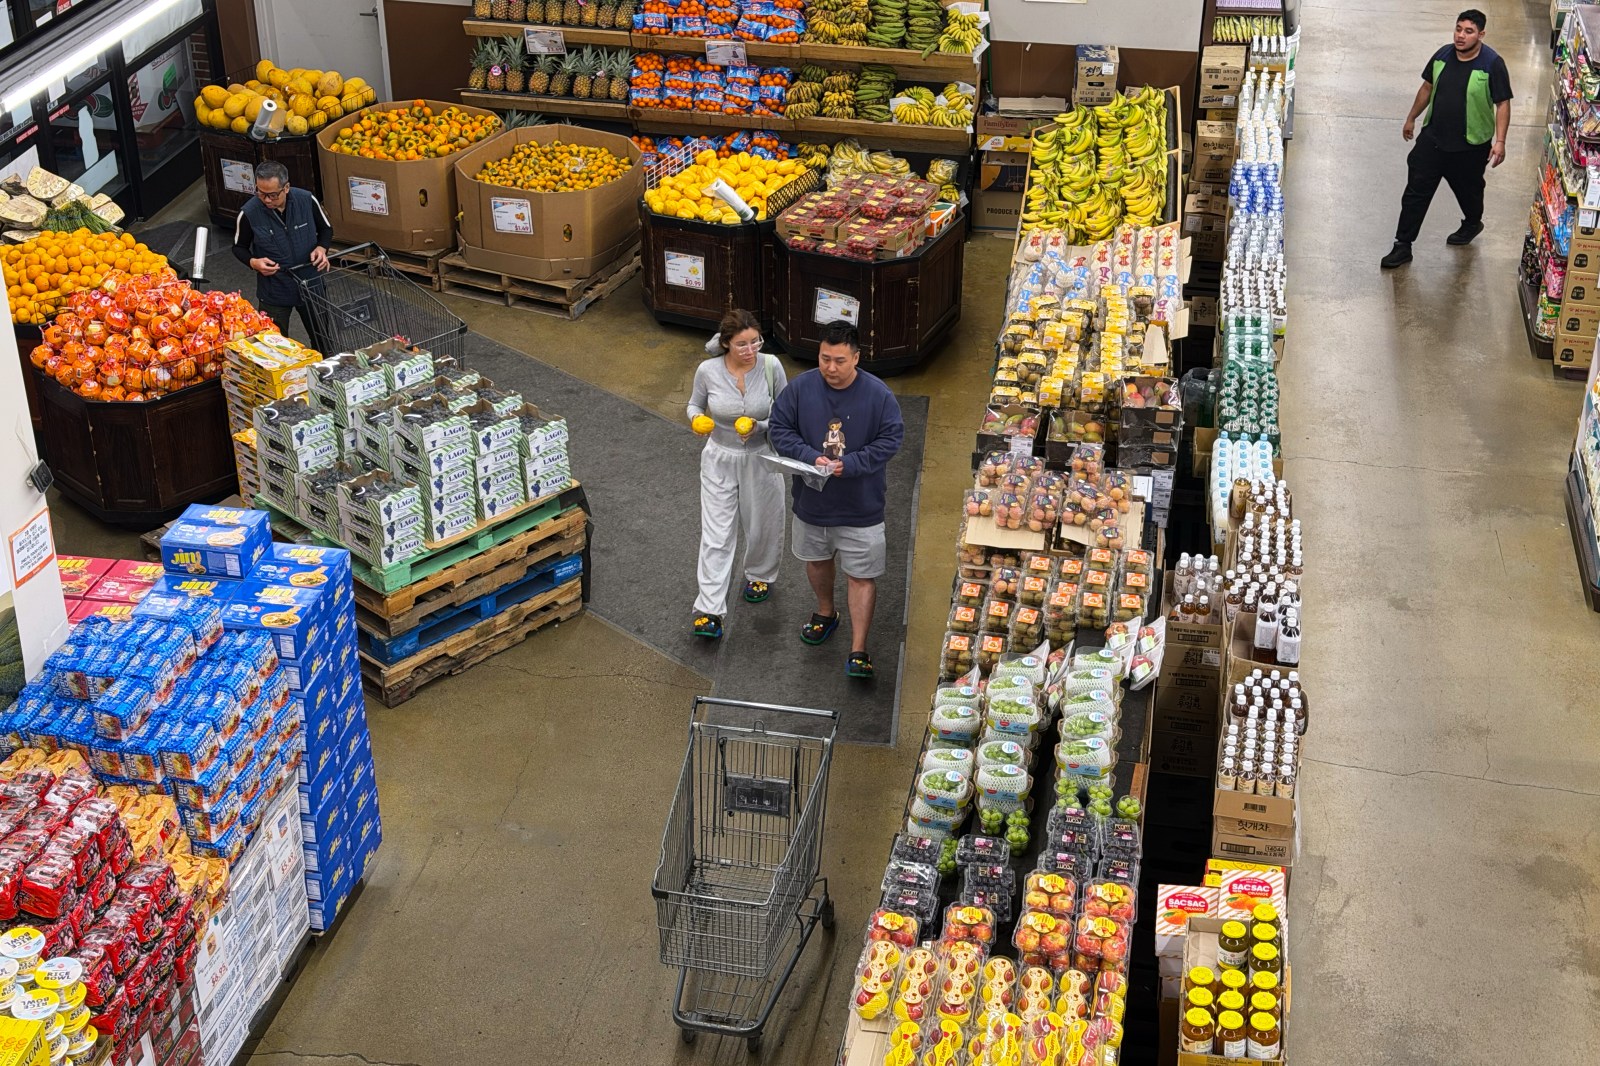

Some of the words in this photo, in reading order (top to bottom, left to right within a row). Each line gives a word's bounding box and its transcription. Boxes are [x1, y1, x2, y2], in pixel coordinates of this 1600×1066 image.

[409, 364, 428, 376] LAGO
[362, 379, 381, 391] LAGO
[309, 423, 330, 435] LAGO
[443, 425, 465, 437] LAGO
[496, 427, 516, 440] LAGO
[544, 429, 562, 442] LAGO
[314, 445, 333, 457] LAGO
[448, 448, 468, 461] LAGO
[494, 451, 514, 462] LAGO
[543, 453, 563, 465] LAGO
[448, 470, 468, 482] LAGO
[496, 472, 515, 484] LAGO
[545, 475, 566, 487] LAGO
[397, 496, 416, 509] LAGO
[449, 491, 469, 504] LAGO
[501, 492, 519, 505] LAGO
[400, 516, 419, 528] LAGO
[450, 515, 470, 528] LAGO
[399, 540, 419, 552] LAGO
[1237, 820, 1270, 831] 헛개차
[22, 997, 49, 1006] BOWL
